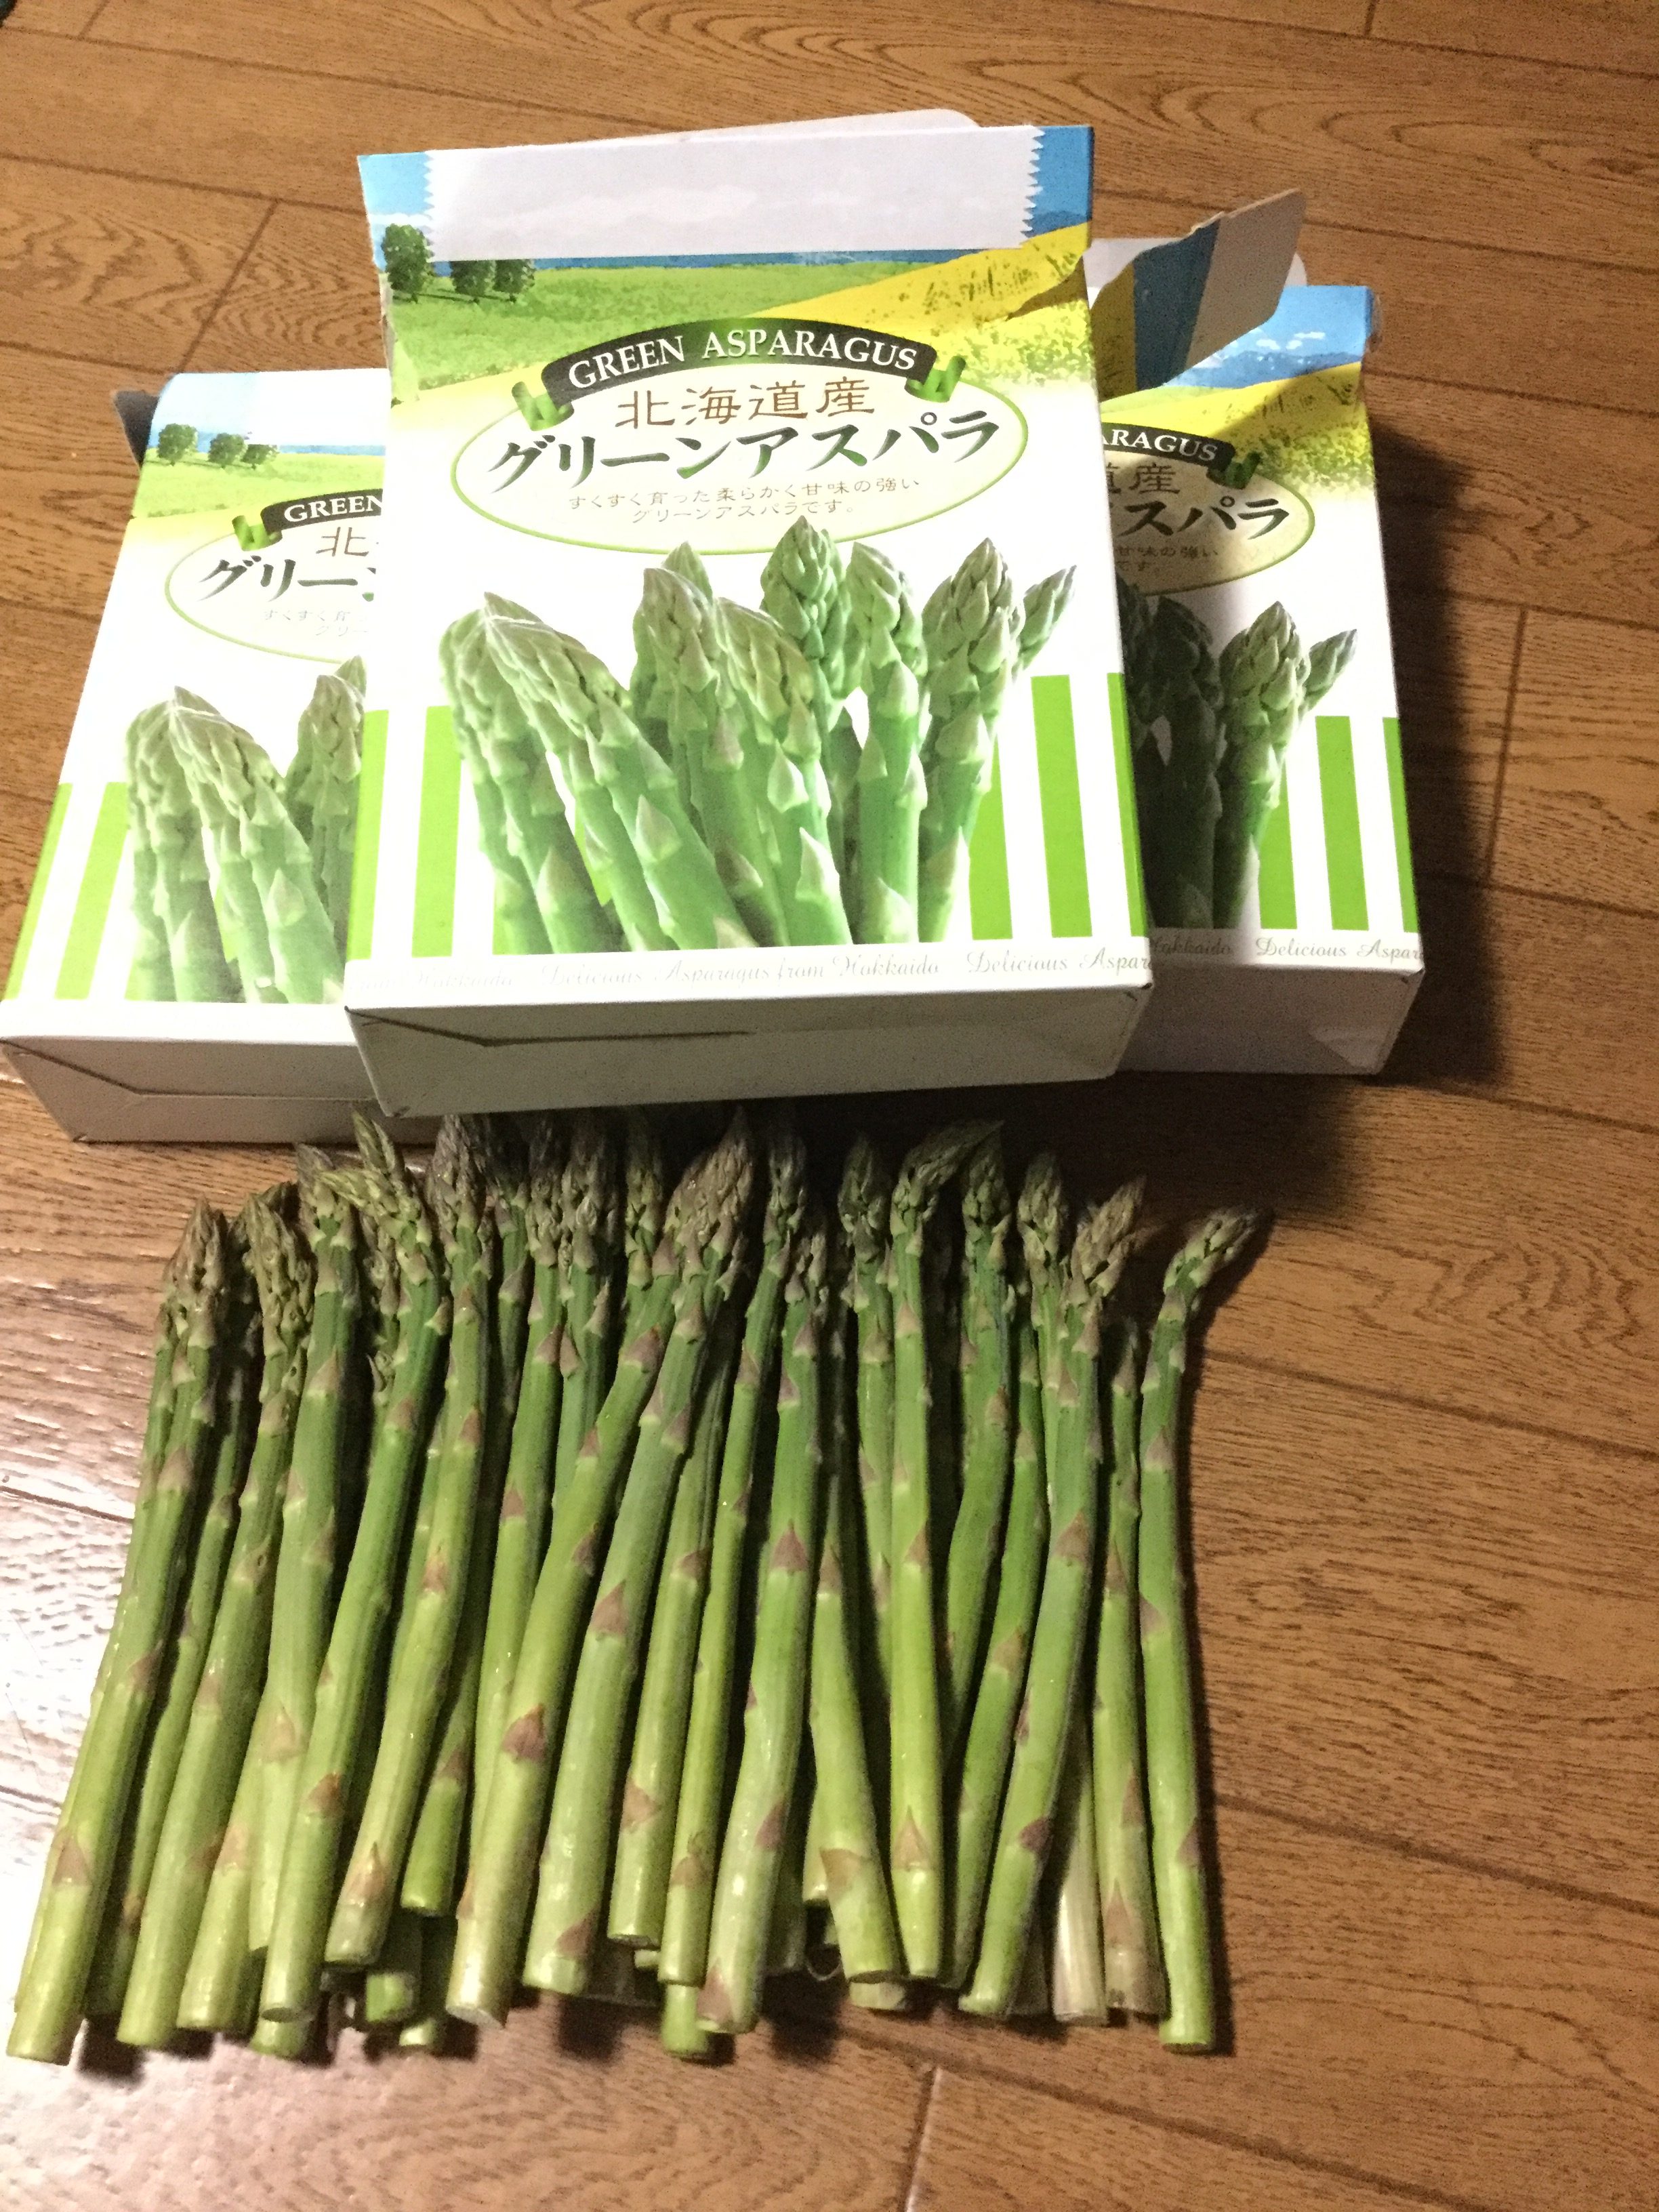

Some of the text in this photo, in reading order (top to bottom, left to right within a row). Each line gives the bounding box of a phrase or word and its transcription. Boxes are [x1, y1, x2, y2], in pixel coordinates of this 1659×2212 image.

[568, 329, 918, 390] GREEN ASPARAGUS
[615, 375, 876, 431] 北海道産
[487, 409, 1000, 494] グリーンアスパラ
[283, 495, 383, 523] GREEN
[569, 477, 920, 510] すくすく育った柔らかく甘味の強い
[632, 499, 854, 524] グリーンアスパラです。
[1110, 495, 1290, 540] スパラ
[315, 527, 379, 557] 北
[1255, 936, 1347, 957] Delicious
[777, 956, 825, 987] from
[832, 954, 940, 978] Hokkaido
[967, 949, 1069, 974] Delicious
